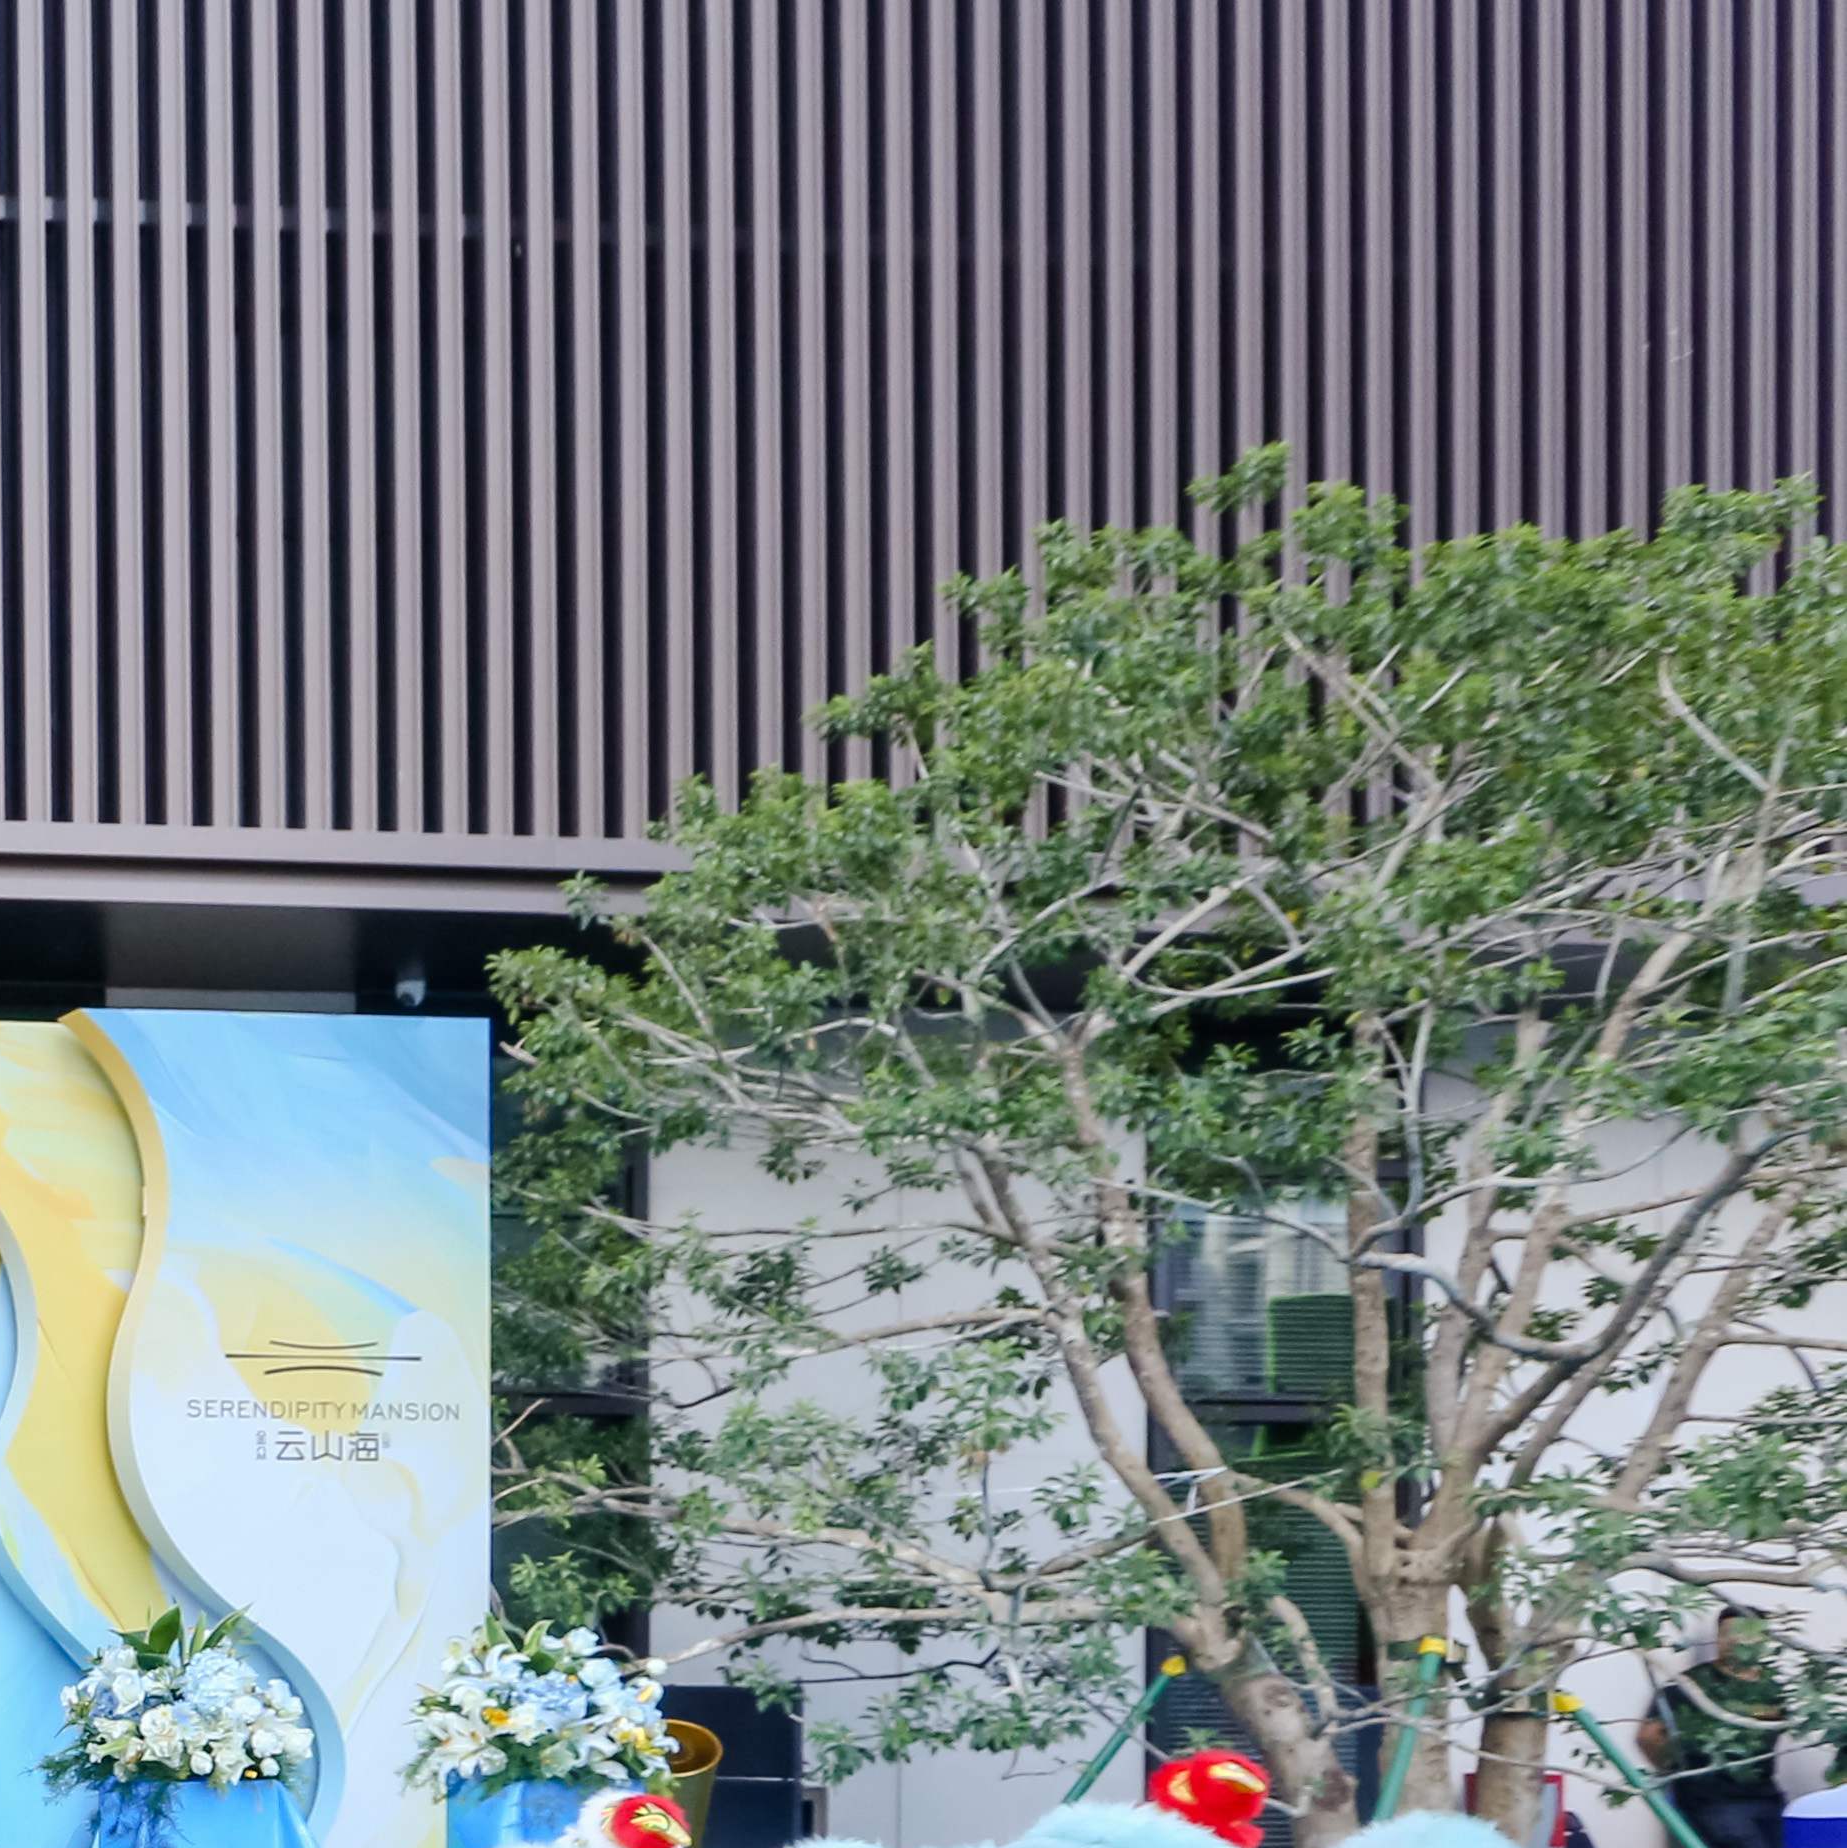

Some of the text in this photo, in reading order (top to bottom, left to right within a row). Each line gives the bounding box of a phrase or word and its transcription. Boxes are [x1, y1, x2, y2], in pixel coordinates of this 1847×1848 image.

[186, 1399, 460, 1422] SERENDIPITY MANSION
[275, 1430, 380, 1462] 云山海
